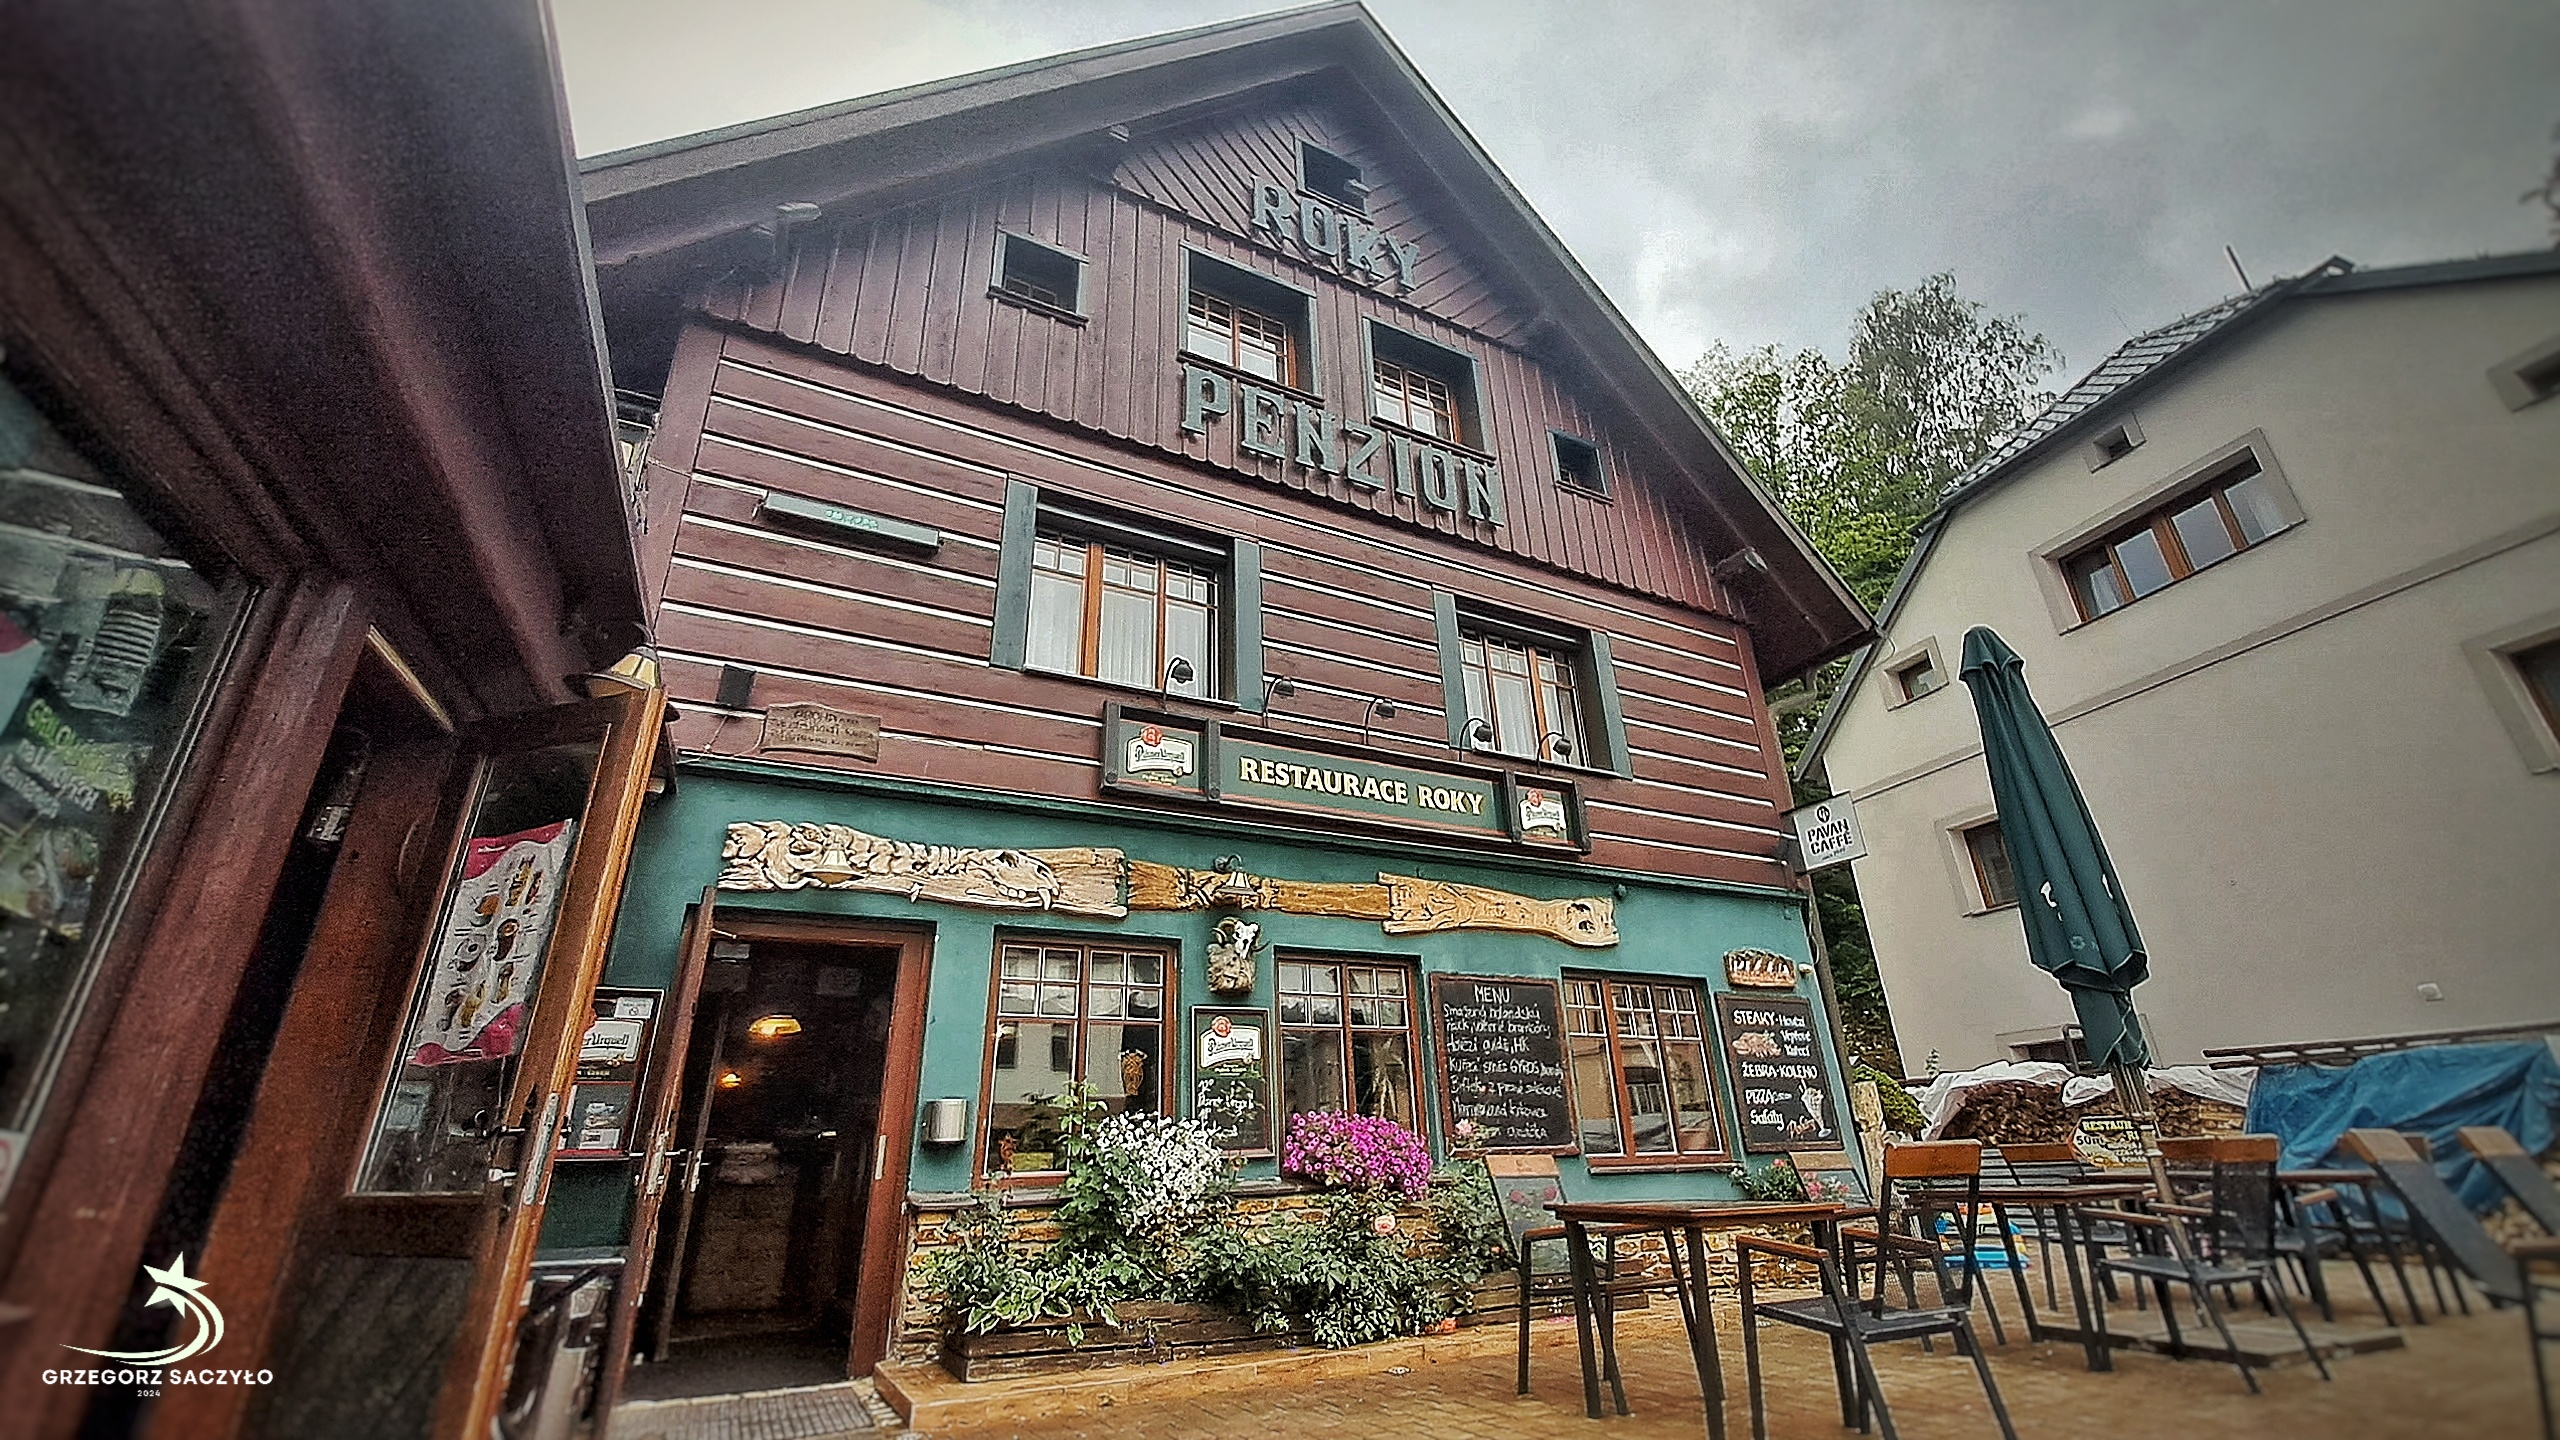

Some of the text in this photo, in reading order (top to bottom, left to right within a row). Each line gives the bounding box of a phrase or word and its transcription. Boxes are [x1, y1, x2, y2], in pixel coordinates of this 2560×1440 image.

[1251, 174, 1420, 291] ROKY
[1180, 363, 1505, 528] PENZION
[1239, 755, 1409, 805] RESTAURACE
[1417, 783, 1484, 816] ROKY
[1807, 818, 1849, 841] PAVAN
[1473, 983, 1511, 1004] MENU
[1509, 1058, 1540, 1075] GYROS
[1744, 1088, 1776, 1106] PIZZA
[2082, 1120, 2134, 1131] RESTAUR
